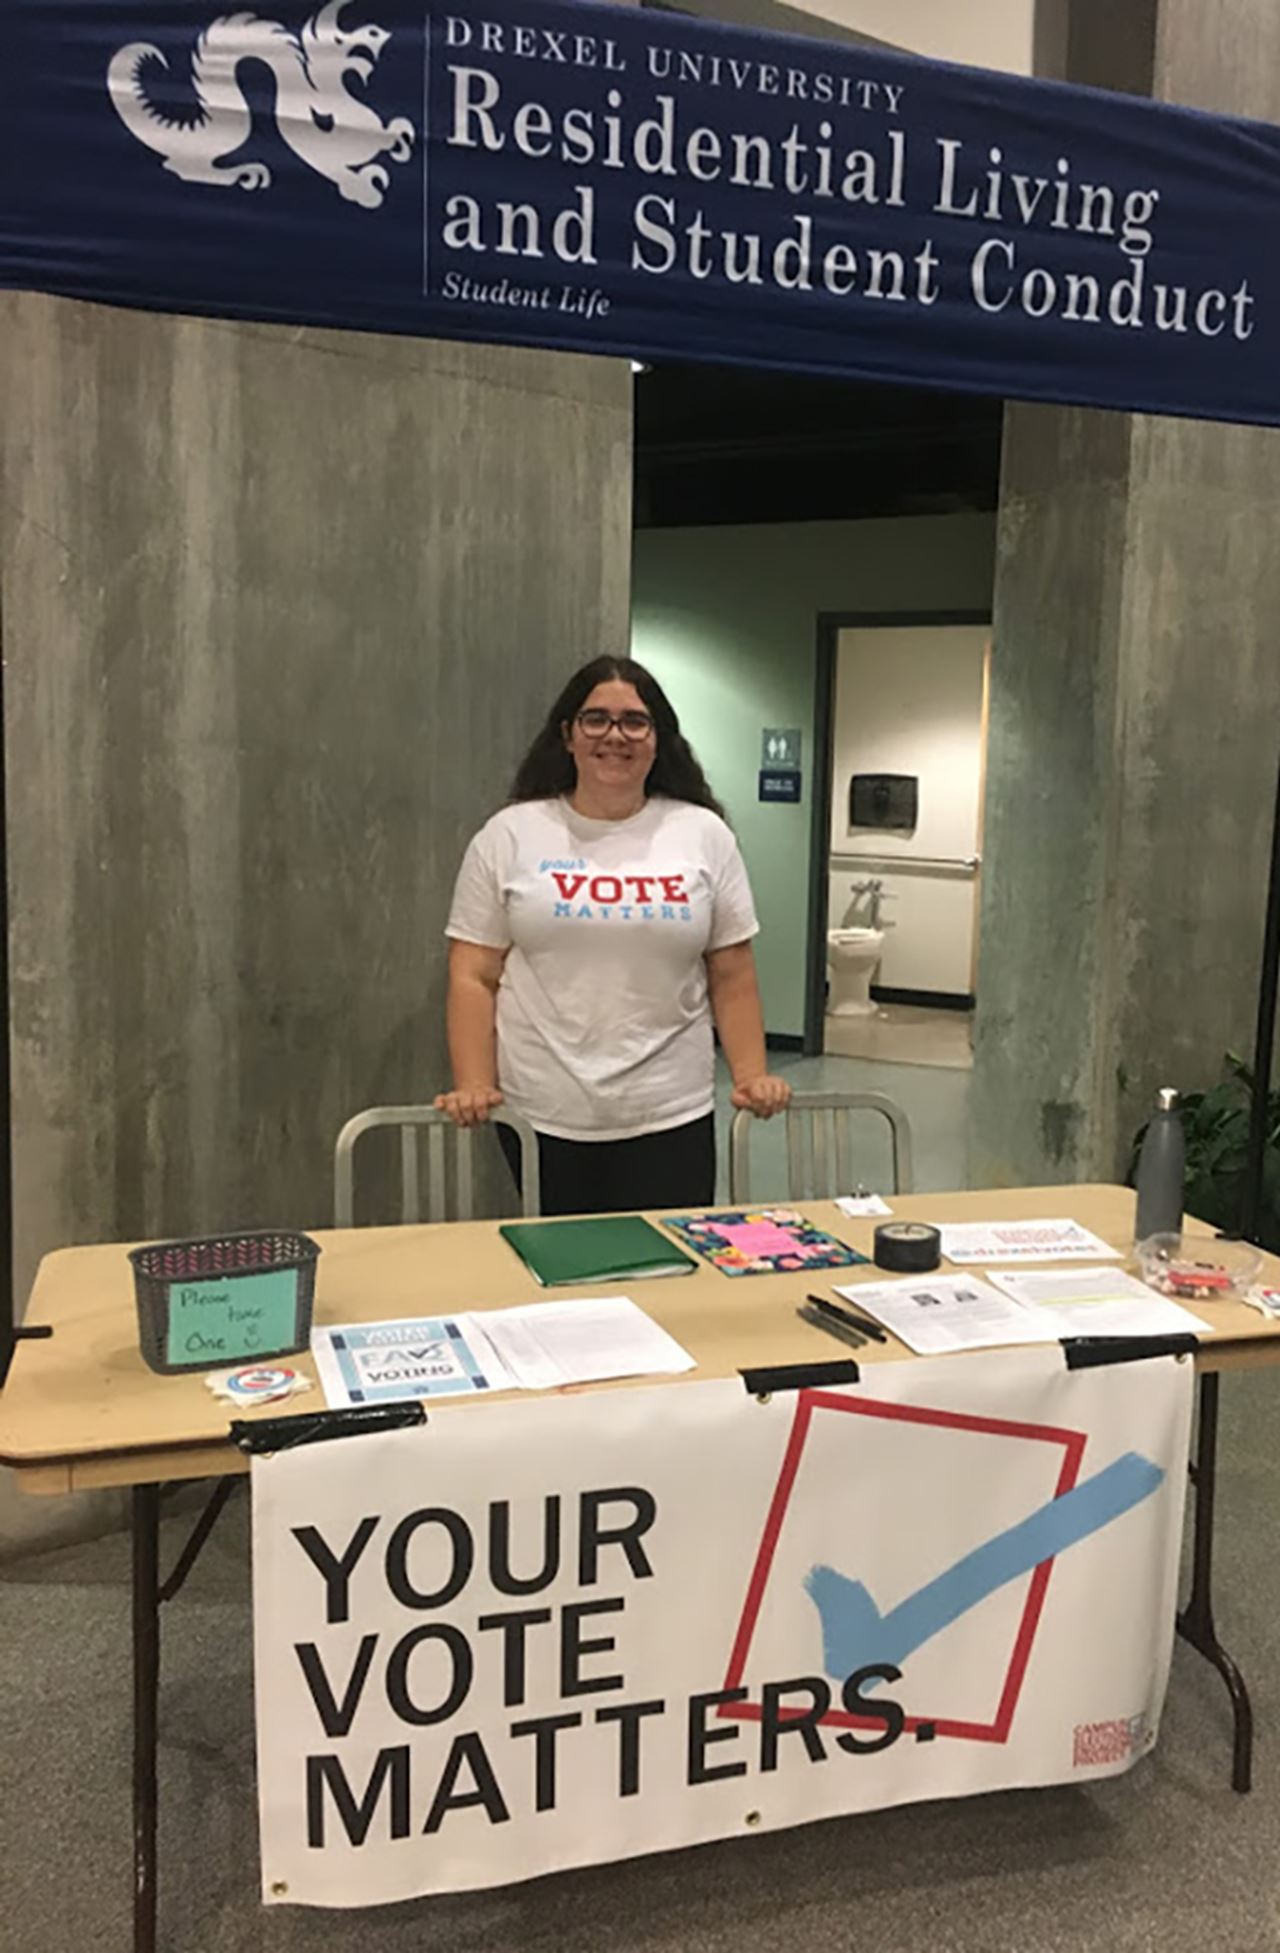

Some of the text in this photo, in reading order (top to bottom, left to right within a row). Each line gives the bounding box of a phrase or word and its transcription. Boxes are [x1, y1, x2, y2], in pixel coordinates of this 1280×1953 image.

[446, 16, 906, 113] DREXEL UNIVERSITY
[446, 65, 1159, 255] Residential Living
[442, 271, 611, 319] Student Life
[443, 186, 1254, 340] and Student Conduct
[552, 872, 689, 903] VOTE
[553, 902, 692, 921] MATTERS
[180, 1288, 230, 1307] Please
[291, 1485, 657, 1624] YOUR
[295, 1597, 625, 1738] VOTE
[306, 1663, 936, 1849] MATTERS.
